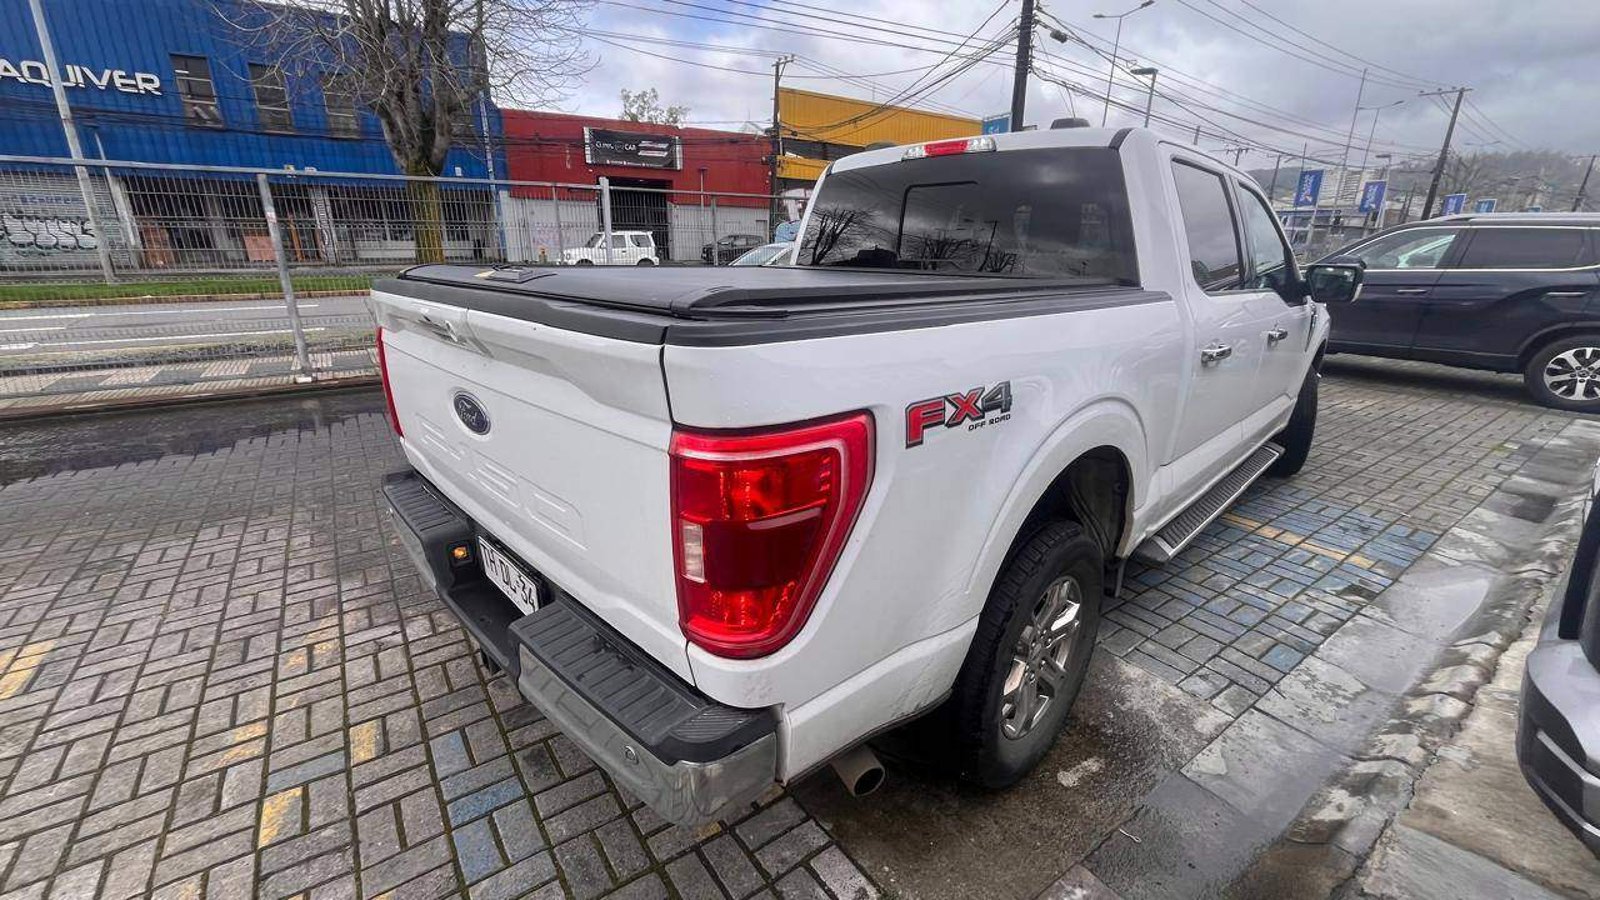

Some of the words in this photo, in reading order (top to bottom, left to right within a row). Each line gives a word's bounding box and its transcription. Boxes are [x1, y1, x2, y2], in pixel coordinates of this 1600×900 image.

[905, 380, 1012, 449] FX4
[968, 421, 986, 432] OFF
[988, 413, 1011, 426] ROAD
